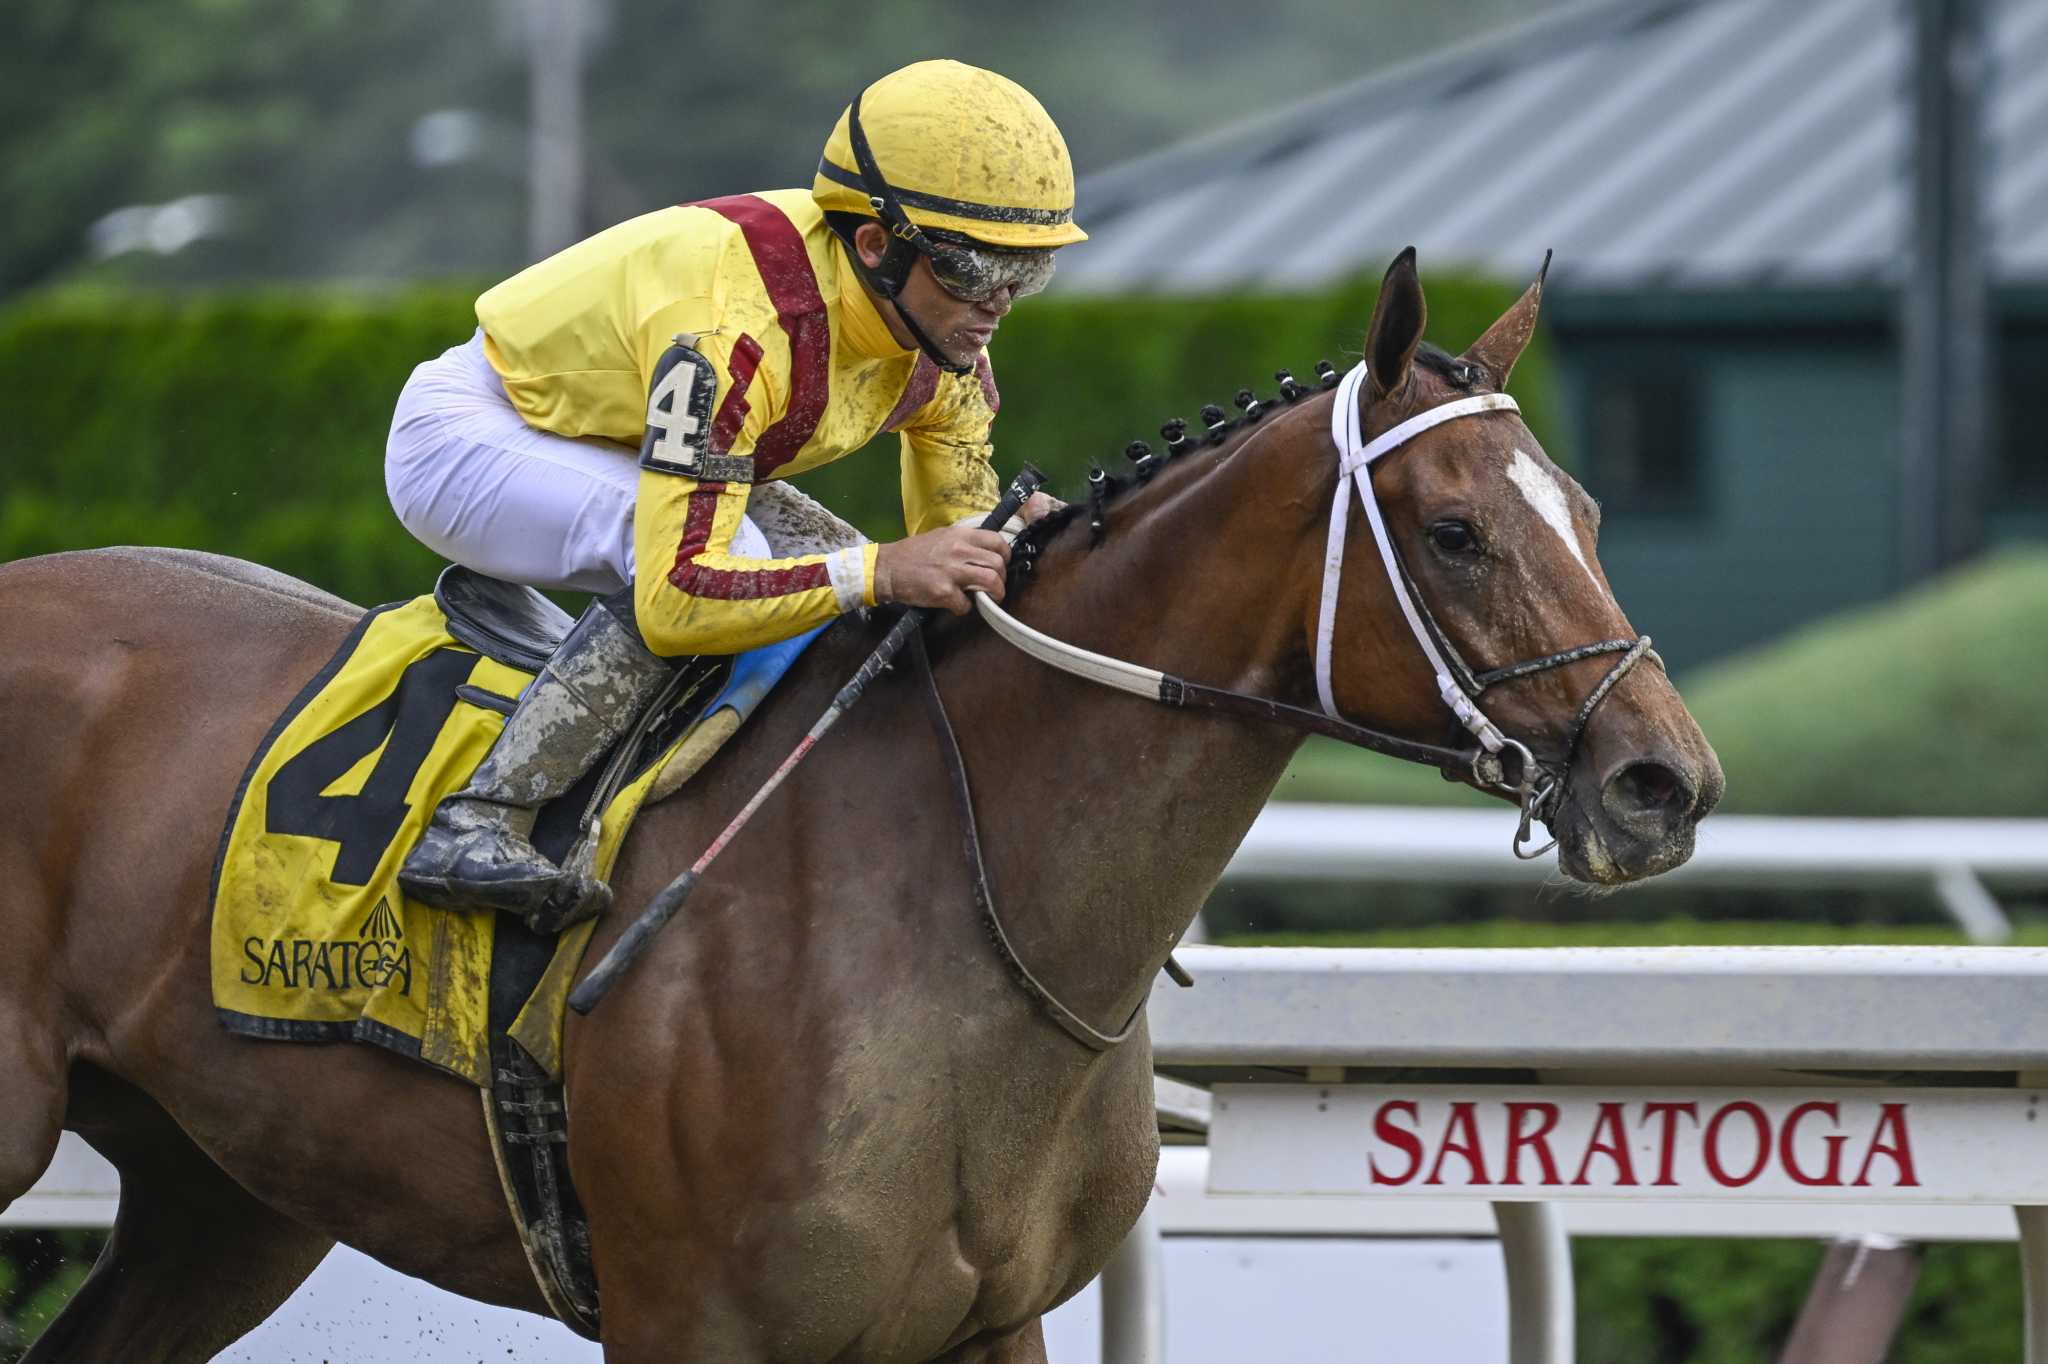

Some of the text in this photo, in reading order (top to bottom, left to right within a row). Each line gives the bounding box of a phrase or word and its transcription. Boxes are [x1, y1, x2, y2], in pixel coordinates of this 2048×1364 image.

[646, 360, 699, 466] 4
[265, 650, 482, 886] 4
[240, 936, 412, 997] SARATOGA
[1367, 1100, 1922, 1188] SARATOGA
